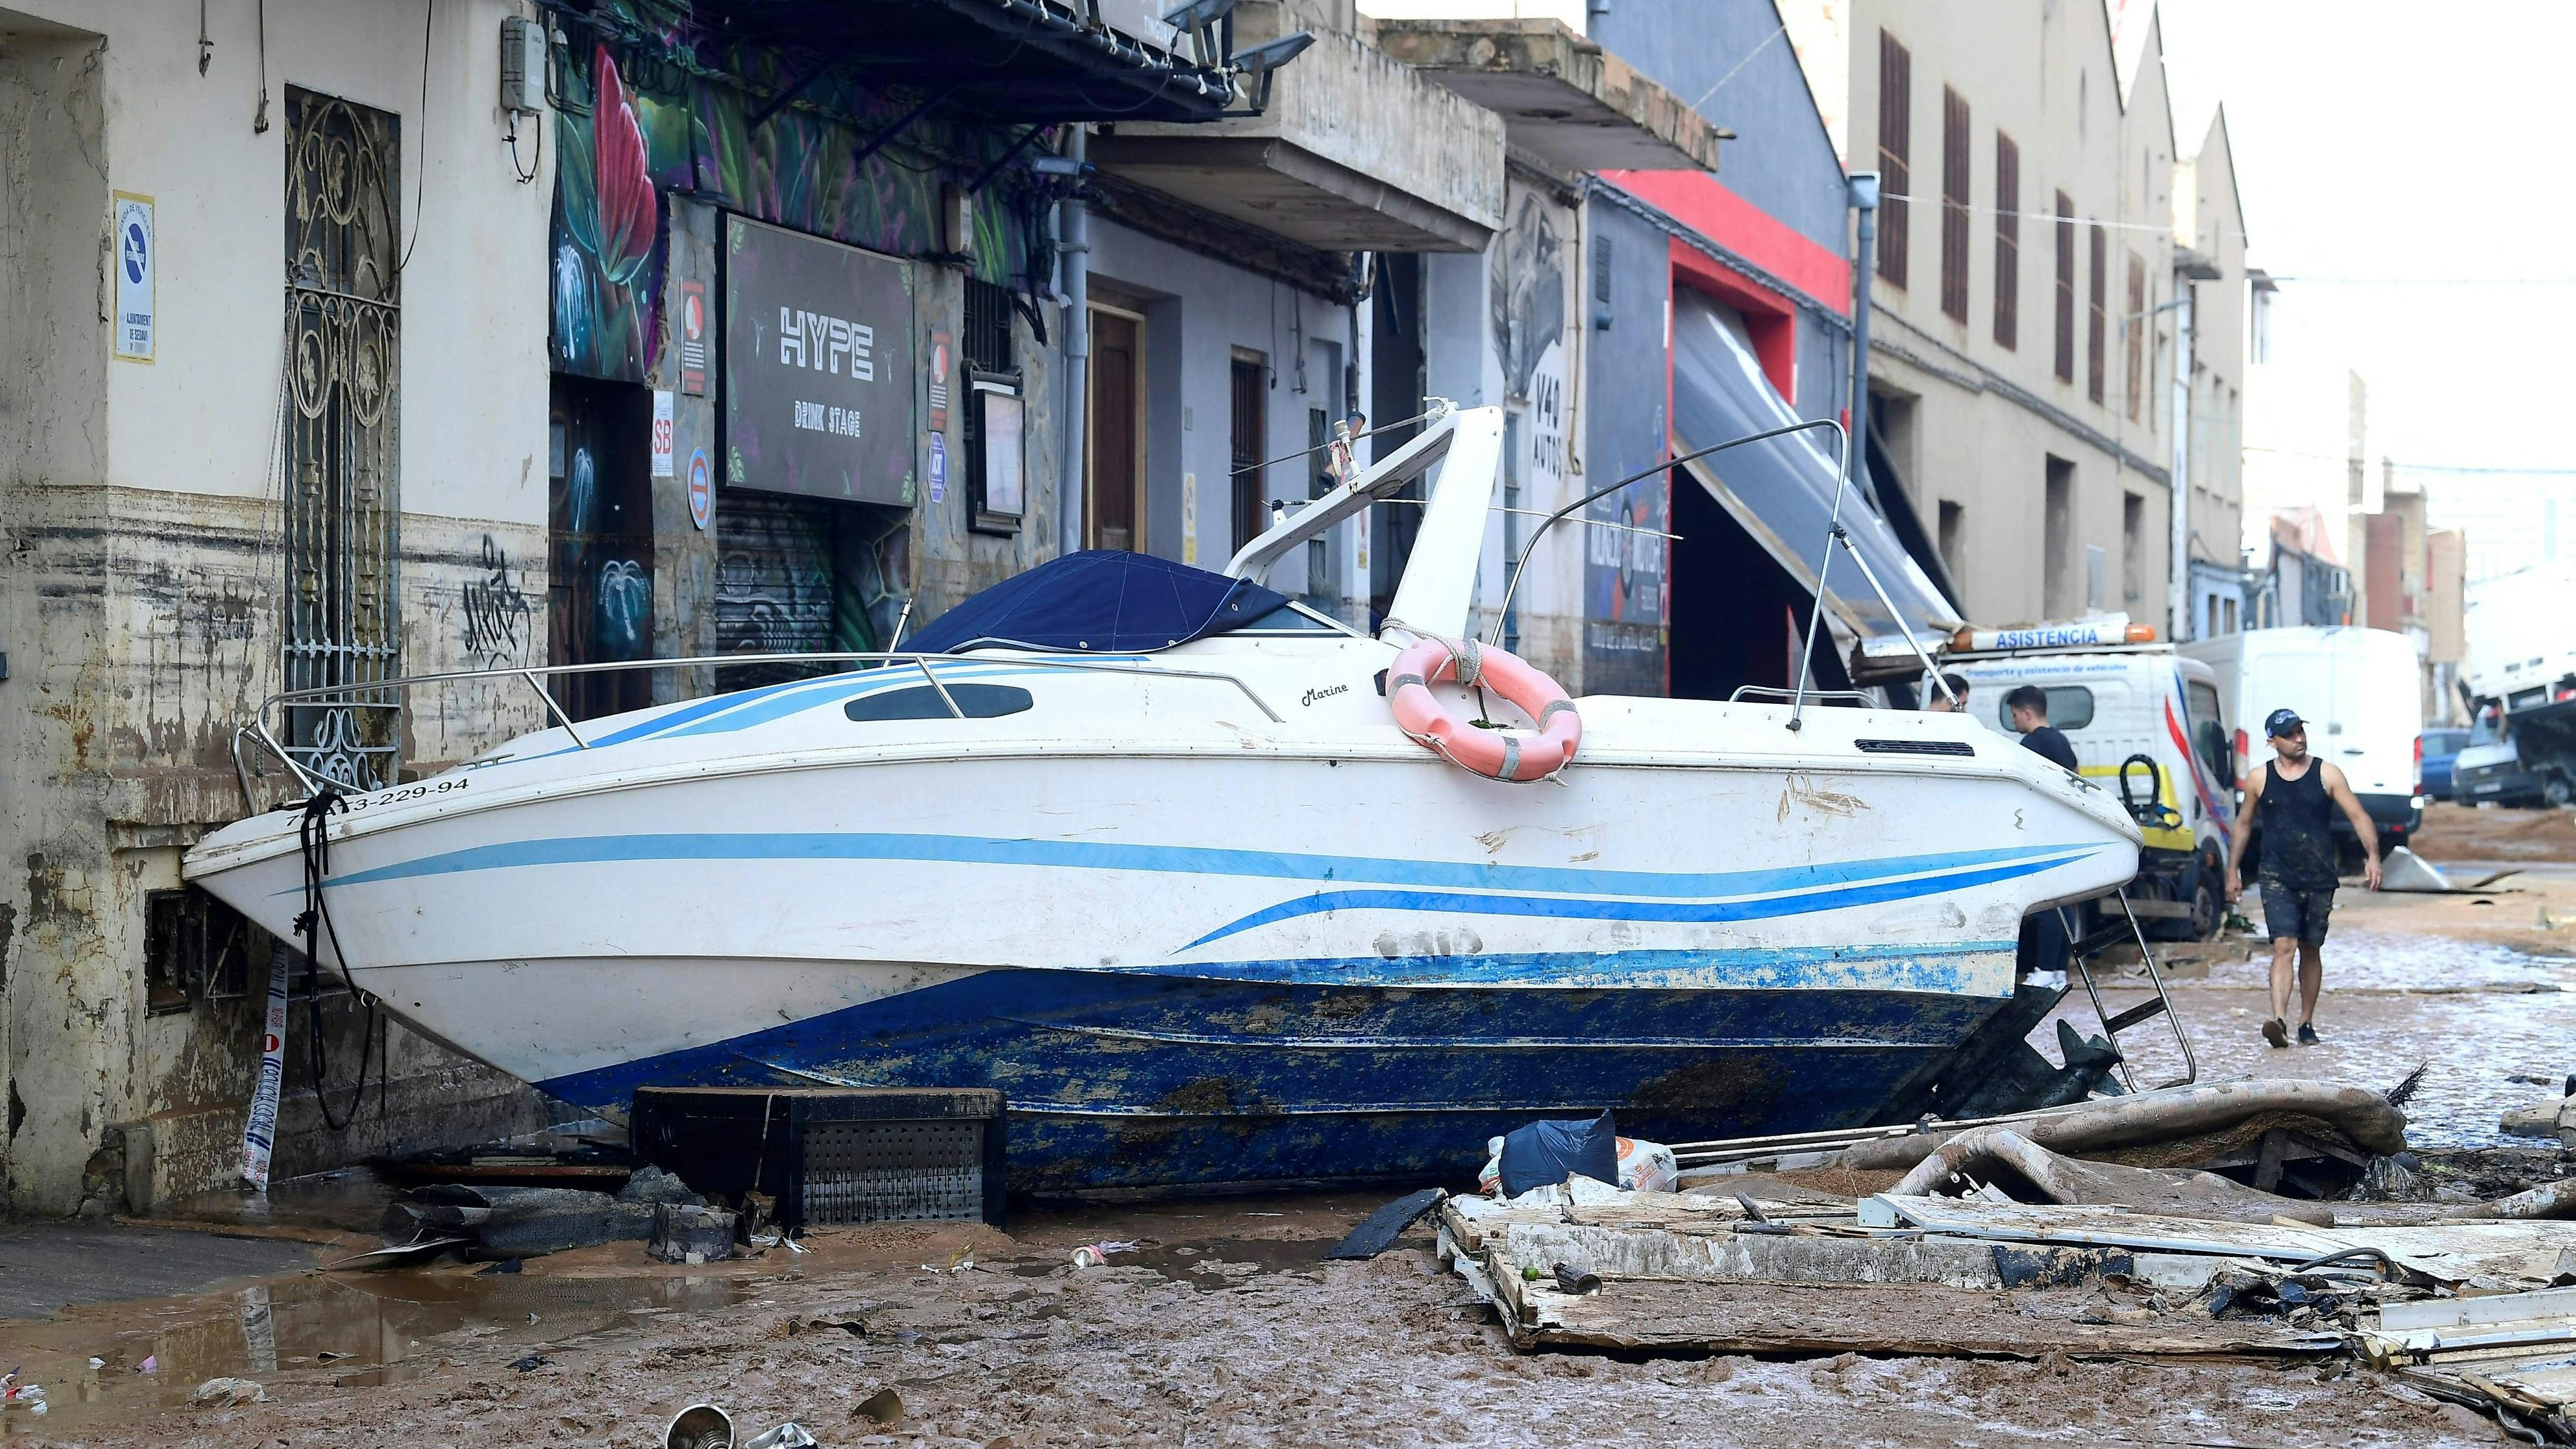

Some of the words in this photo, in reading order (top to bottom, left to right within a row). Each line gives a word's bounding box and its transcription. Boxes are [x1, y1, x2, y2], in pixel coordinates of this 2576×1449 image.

[127, 312, 151, 326] AJUNTAMENT
[781, 307, 873, 381] HYPE
[1537, 373, 1560, 430] V40
[794, 400, 825, 431] DRINK
[828, 406, 860, 438] STAGE
[654, 419, 671, 454] SB
[1533, 434, 1562, 481] AUTOS
[1996, 629, 2098, 648] ASISTENCIA
[1965, 668, 2014, 677] Transporte
[1302, 685, 1349, 706] Marine
[250, 1103, 276, 1133] LOCAL
